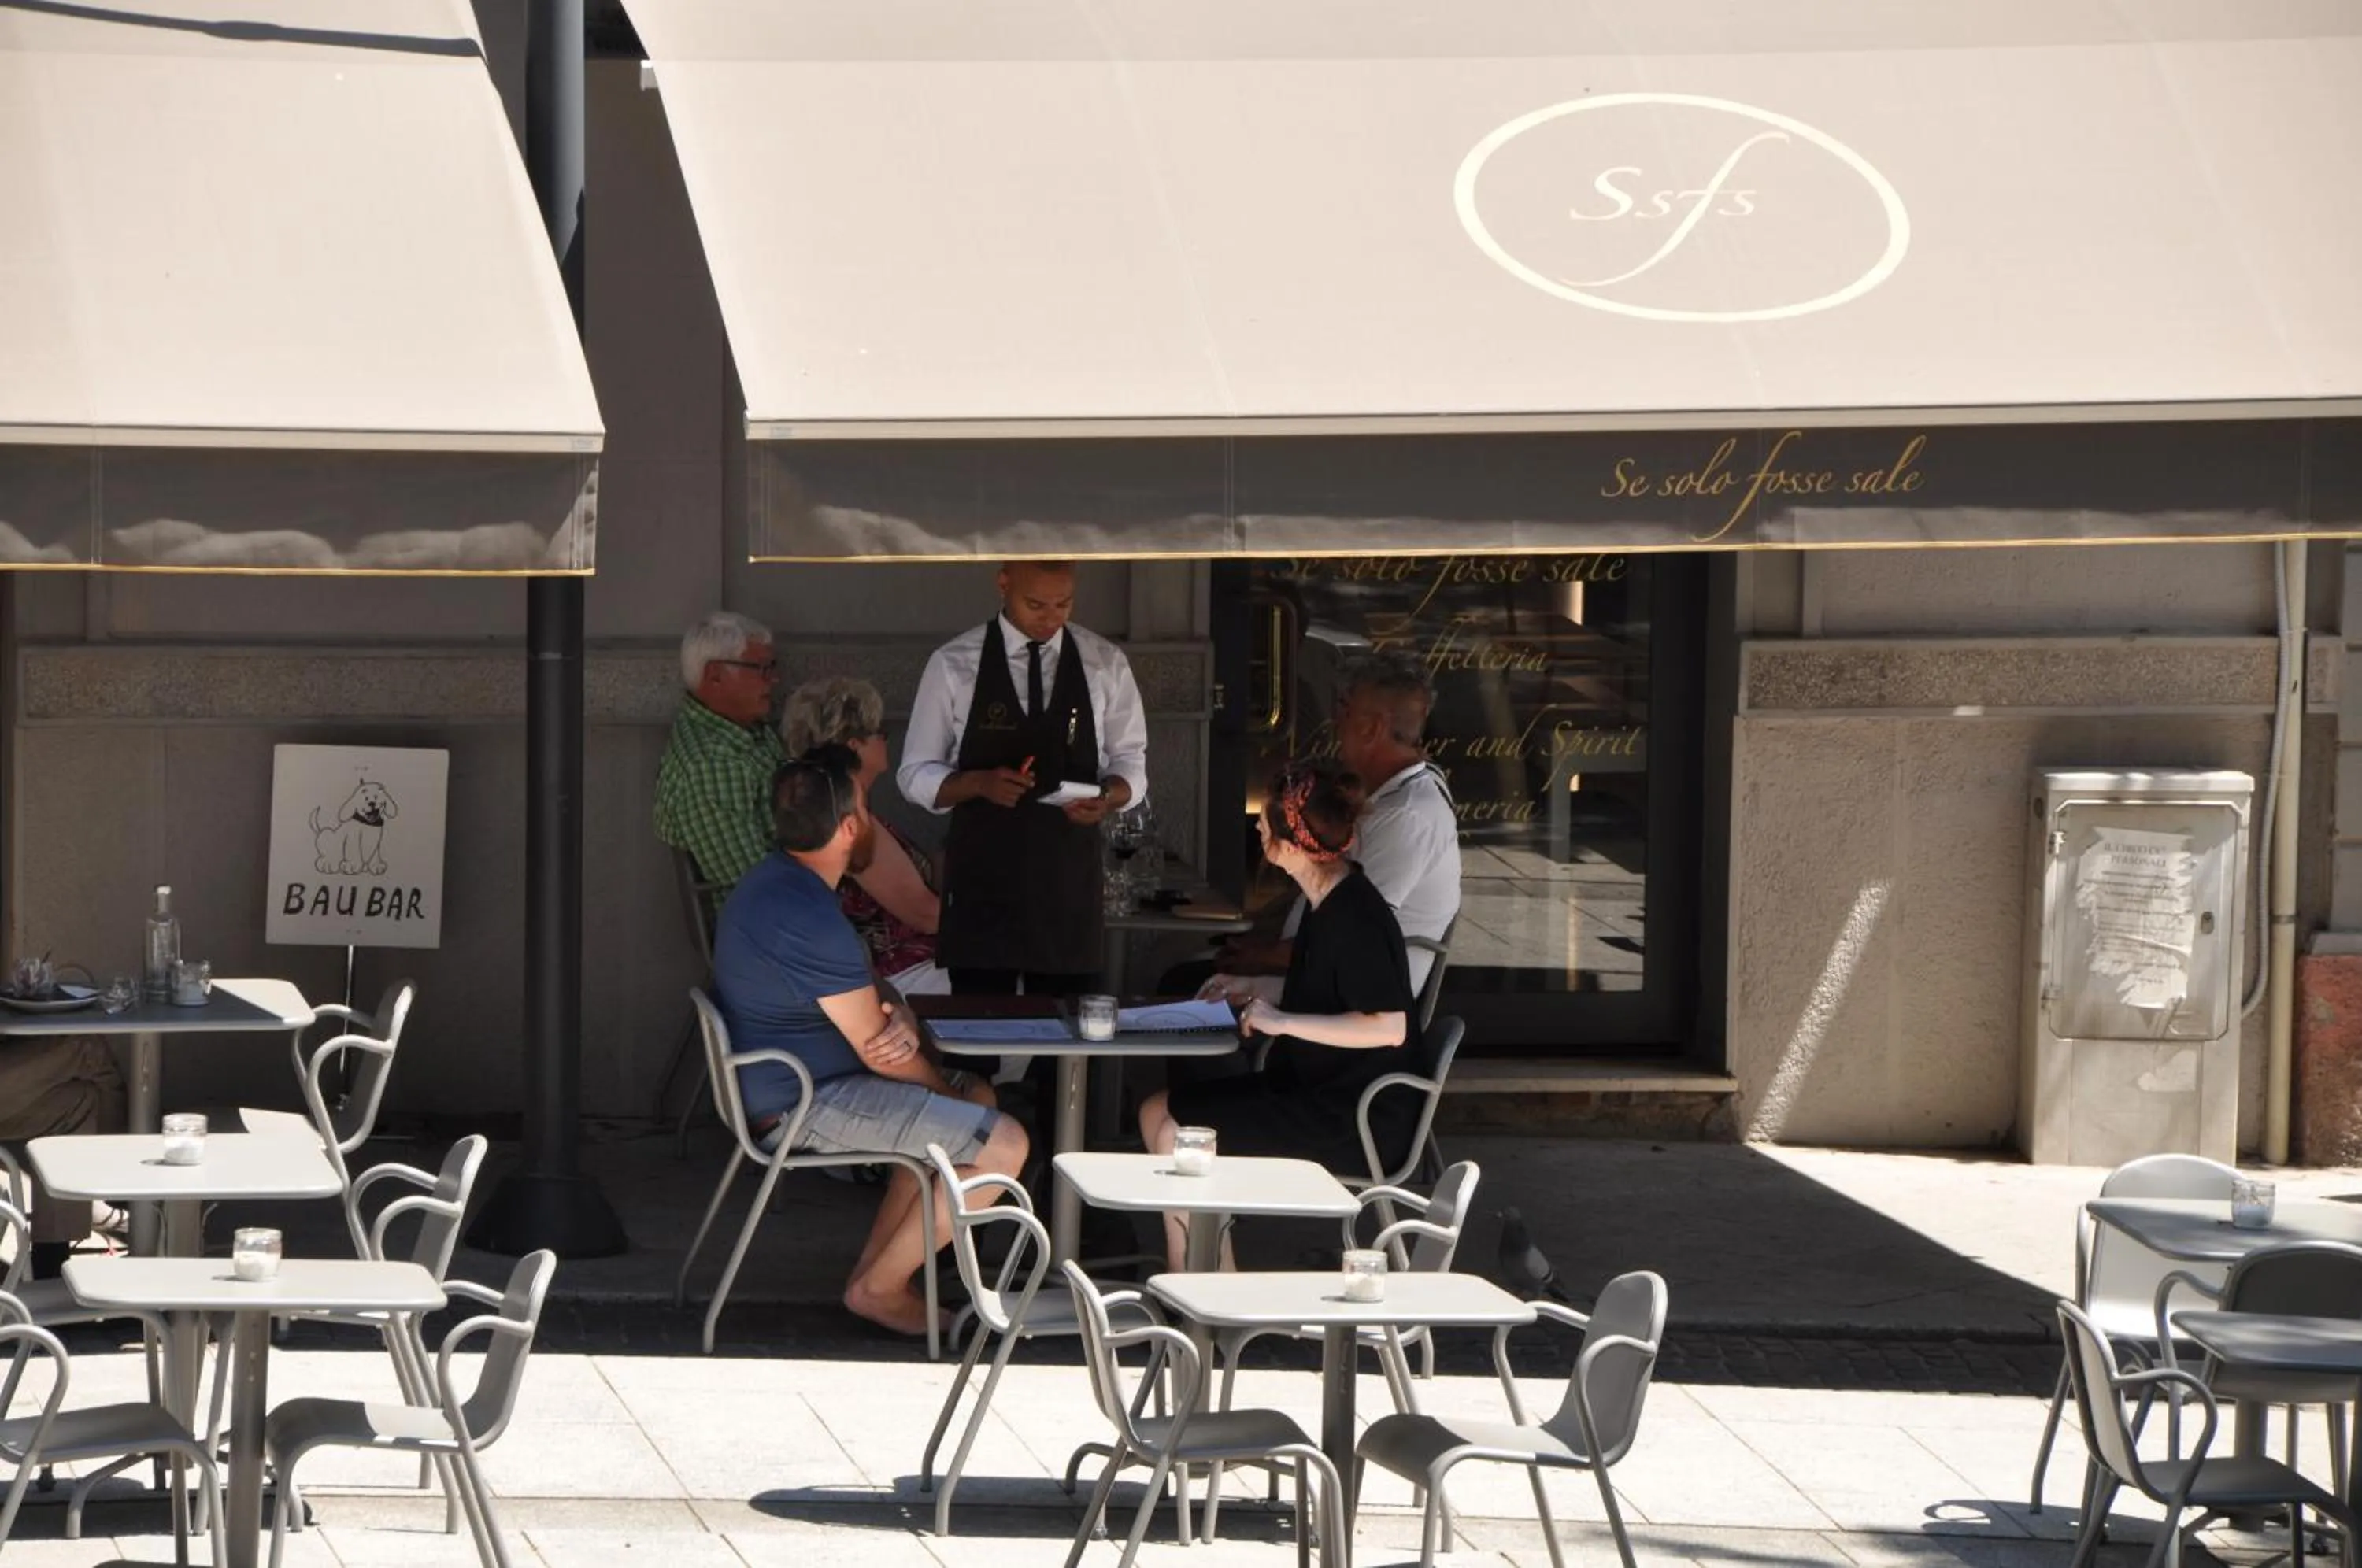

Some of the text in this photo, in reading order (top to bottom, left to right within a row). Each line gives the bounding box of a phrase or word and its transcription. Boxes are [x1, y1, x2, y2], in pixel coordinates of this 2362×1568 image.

[1601, 430, 1927, 542] Se solo fosse sale
[1466, 703, 1557, 760] and
[1540, 719, 1645, 793] Spirit
[283, 882, 425, 921] BAU BAR
